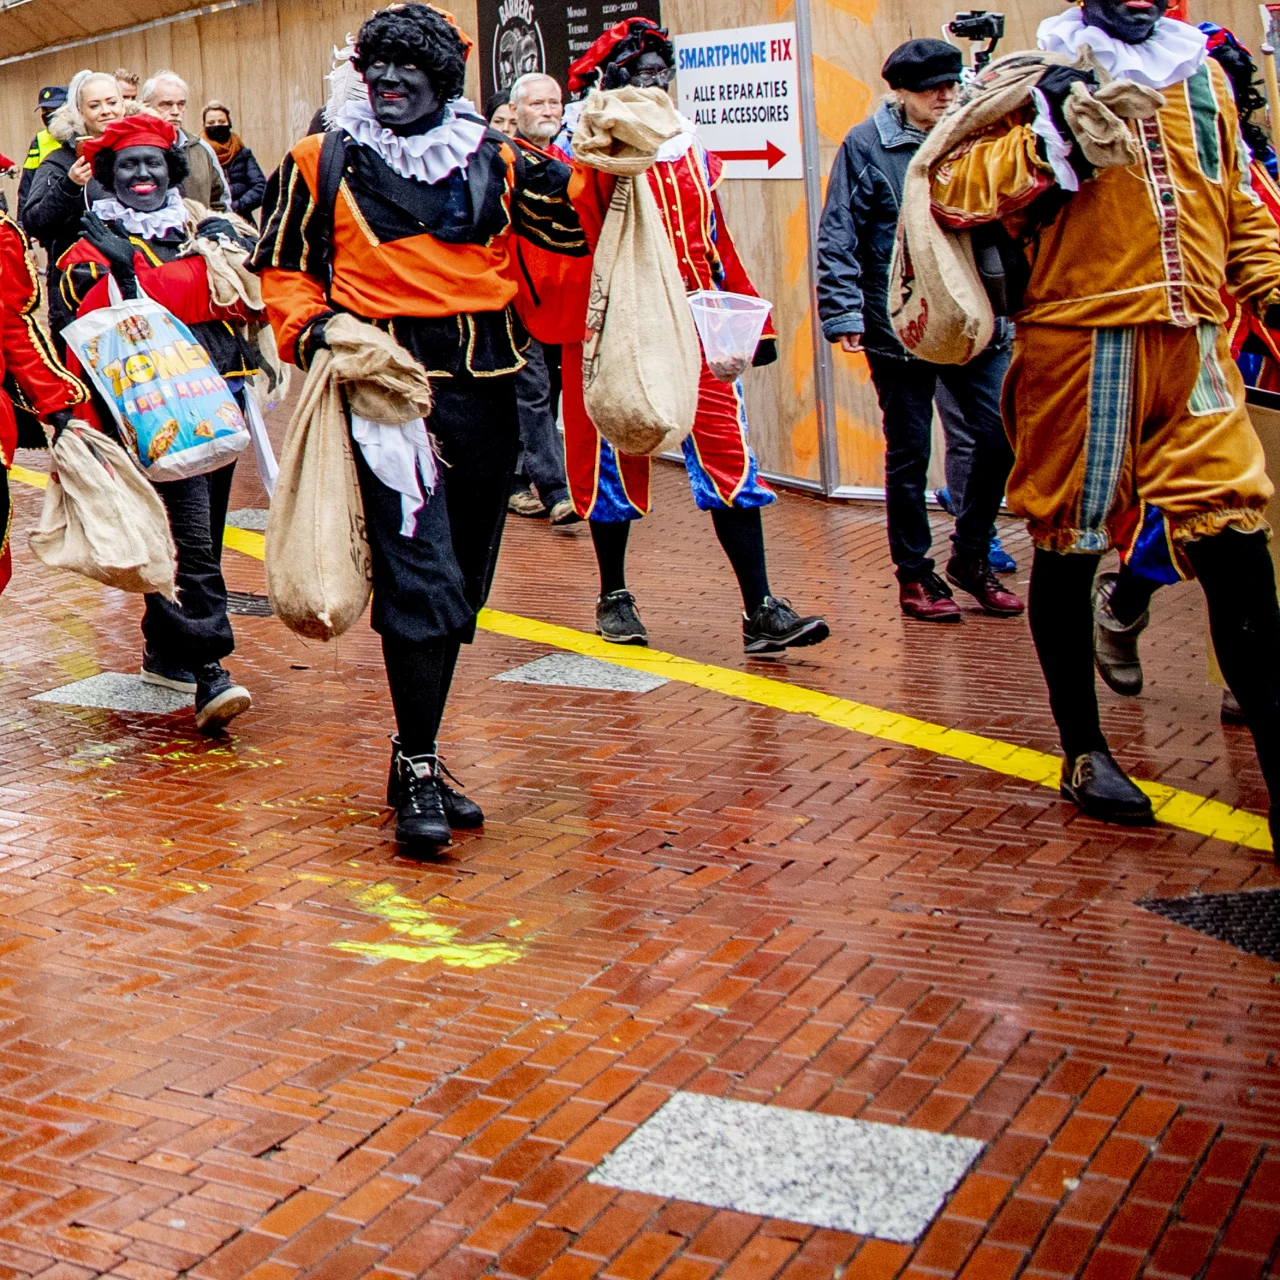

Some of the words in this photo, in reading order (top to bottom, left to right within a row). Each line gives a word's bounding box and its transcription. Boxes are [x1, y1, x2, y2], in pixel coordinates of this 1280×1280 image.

[679, 41, 766, 70] SMARTPHONE
[770, 38, 792, 62] FIX
[693, 85, 716, 102] ALLE
[719, 80, 788, 101] REPARATIES
[695, 108, 717, 125] ALLE
[721, 104, 789, 124] ACCESSOIRES
